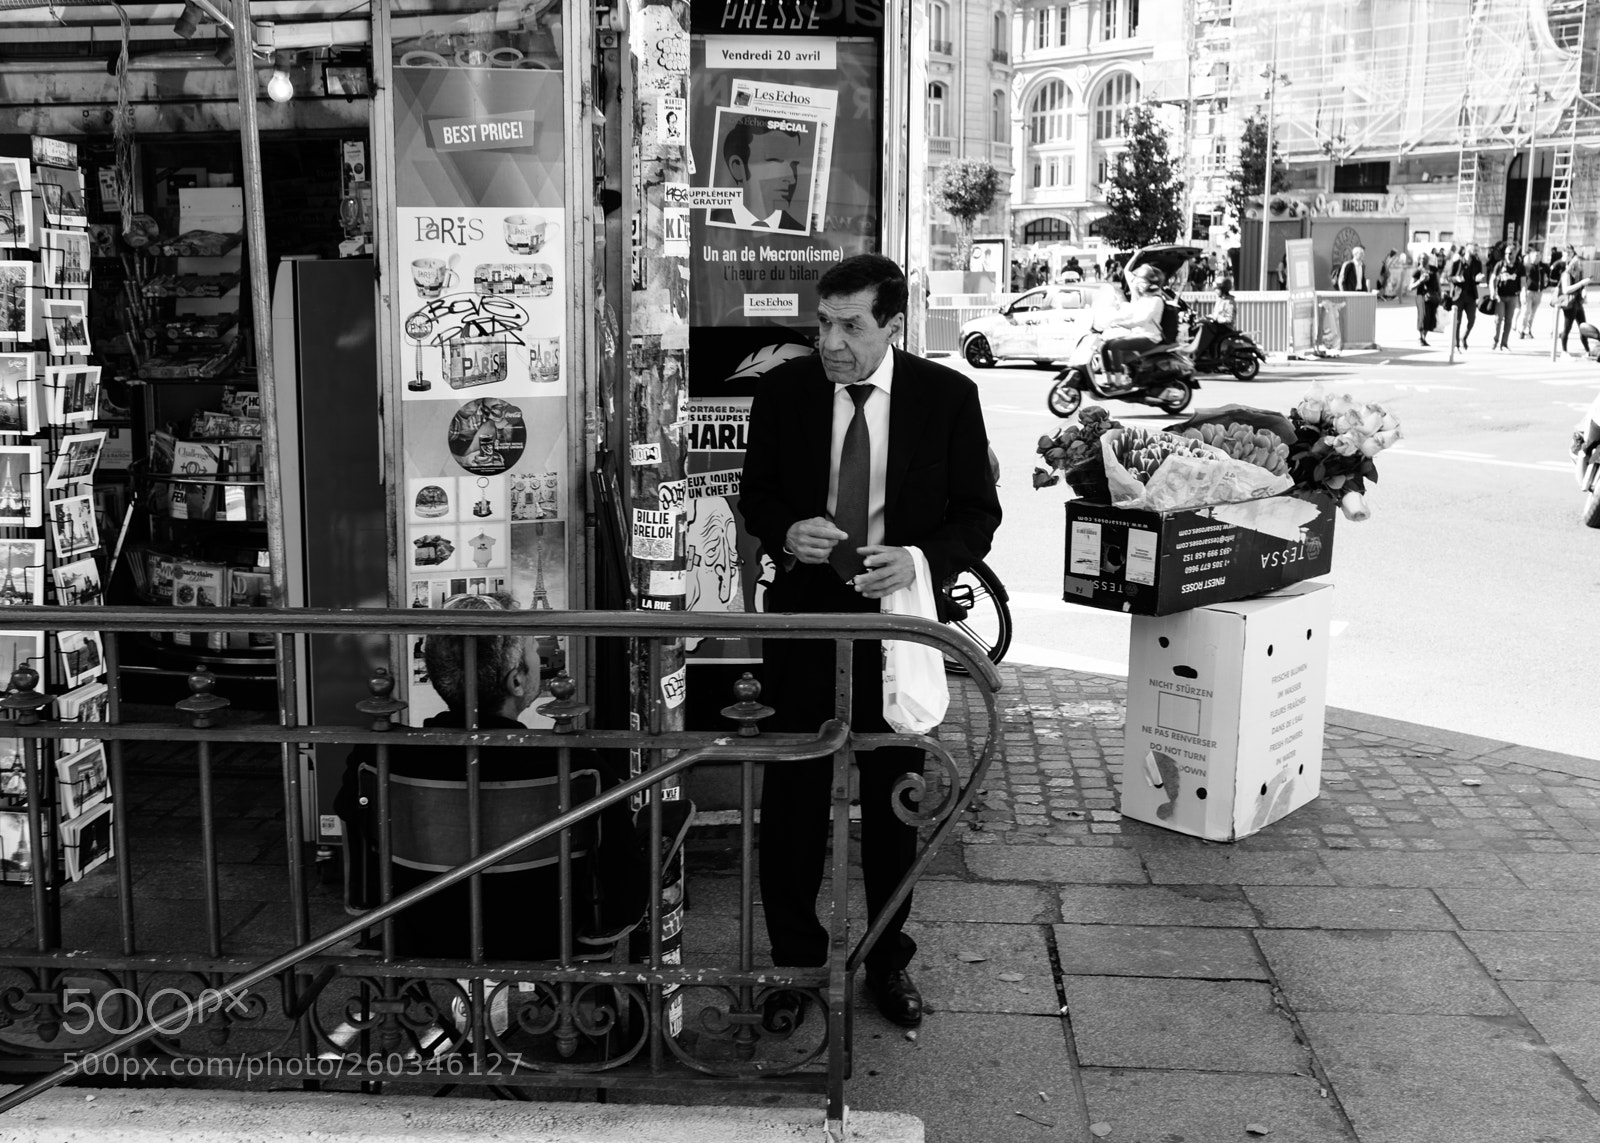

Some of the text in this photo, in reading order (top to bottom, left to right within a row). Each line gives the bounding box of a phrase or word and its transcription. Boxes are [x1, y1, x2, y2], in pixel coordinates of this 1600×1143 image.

[720, 0, 821, 29] PRESSE
[722, 49, 821, 61] Vendredi 20 avril
[754, 88, 811, 104] Les Echos
[443, 121, 524, 145] BEST PRICE!
[767, 120, 809, 133] SPÉCIAL
[1342, 199, 1380, 212] BAGELSTEIN
[703, 245, 844, 263] Un an de Macron(isme)
[724, 264, 819, 281] l'heure du bilan
[750, 297, 793, 307] Les Echos
[688, 487, 702, 499] UN
[705, 484, 728, 496] CHEF
[637, 510, 670, 525] BILLIE
[1077, 516, 1149, 528] www.tessaroses.com
[634, 524, 674, 539] BRELOK
[1175, 534, 1236, 550] info@tessaroses.com
[1182, 554, 1194, 562] 152
[1195, 551, 1206, 560] 458
[1260, 546, 1306, 569] TESSA
[1085, 580, 1124, 593] TESS
[1181, 576, 1226, 594] FINEST ROSES
[642, 599, 672, 610] LA RUE
[1149, 678, 1213, 698] NICHT STÜRZEN
[1142, 725, 1217, 748] NE PAS RENVERSER
[1150, 742, 1206, 762] DO NOT TURN
